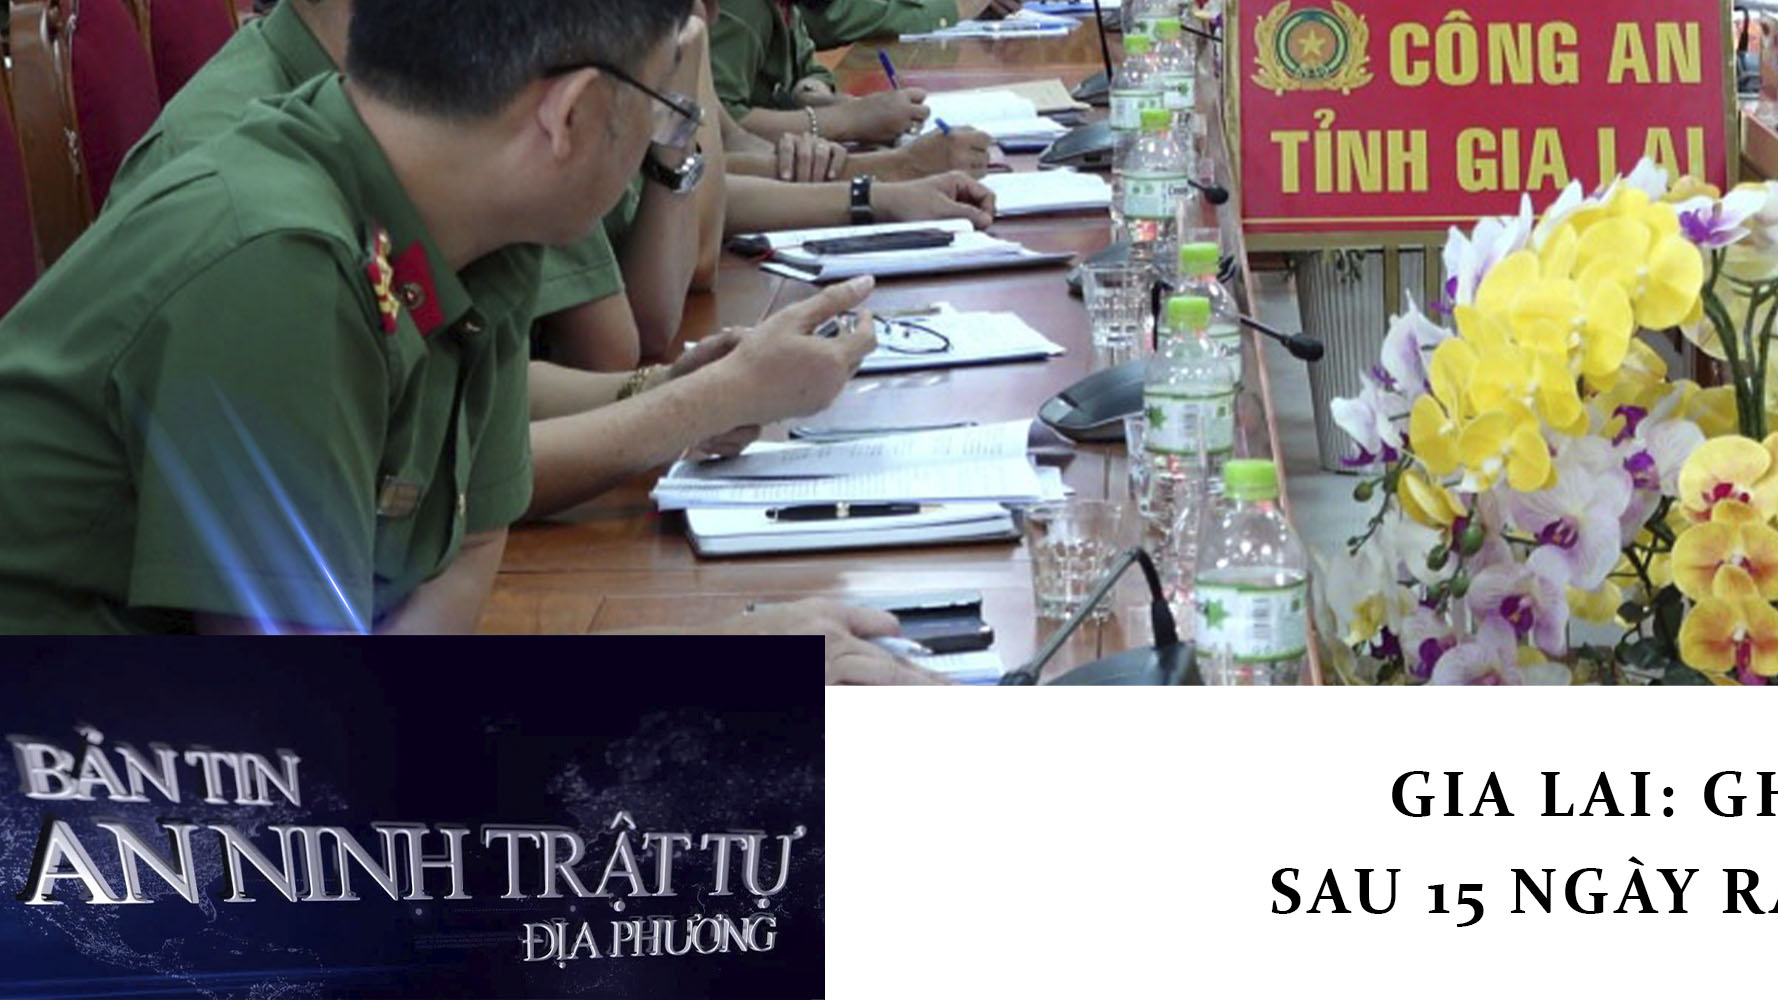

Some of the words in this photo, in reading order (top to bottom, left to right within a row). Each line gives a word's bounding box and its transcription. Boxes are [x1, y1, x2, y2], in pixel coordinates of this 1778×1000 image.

[1389, 10, 1579, 85] CÔNG
[1607, 22, 1699, 84] AN
[1271, 108, 1429, 193] TỈNH
[1456, 128, 1571, 191] GIA
